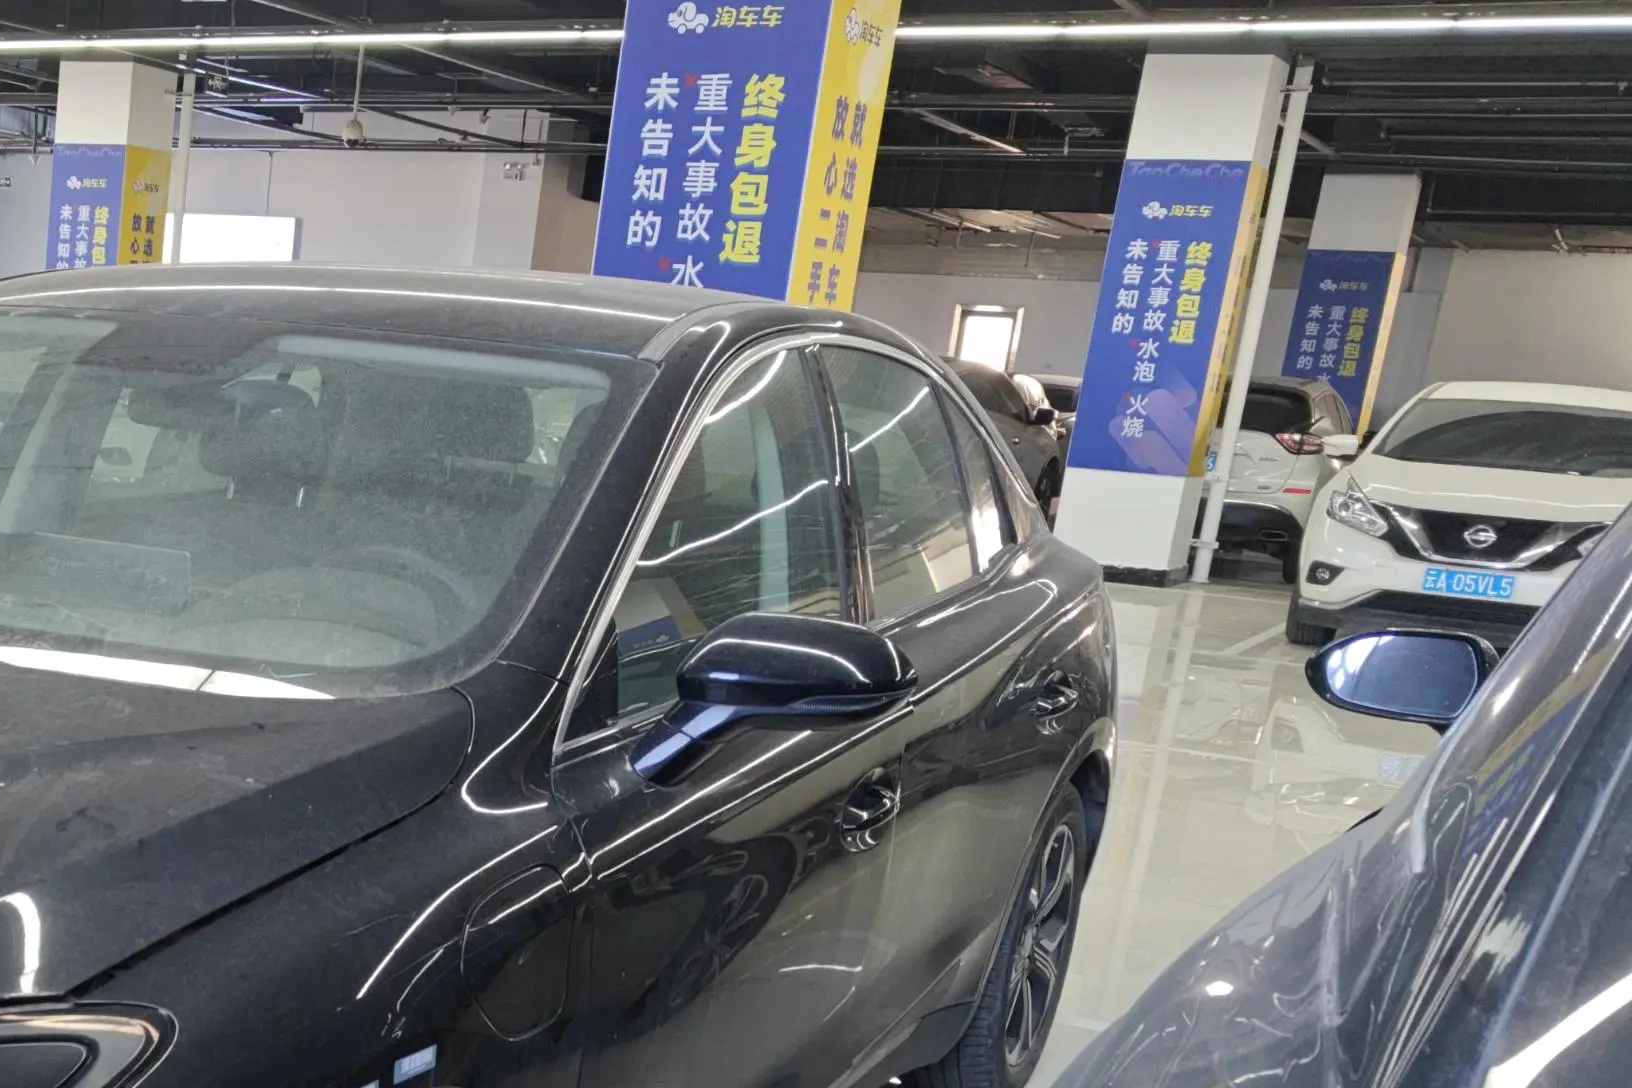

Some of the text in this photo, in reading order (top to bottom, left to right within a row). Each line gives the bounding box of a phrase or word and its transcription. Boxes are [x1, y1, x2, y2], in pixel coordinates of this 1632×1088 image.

[711, 5, 785, 28] 淘车车
[626, 72, 680, 248] 未告知的
[676, 73, 732, 242] 重大事故
[718, 73, 786, 264] 终身包退
[1169, 204, 1214, 218] 淘车车
[1111, 239, 1149, 335] 未告知的
[1168, 240, 1213, 345] 终身包退
[1296, 304, 1324, 370] 未告知的
[1120, 239, 1181, 438] 重大事故 水泡 火烧
[1337, 307, 1369, 377] 终身包退
